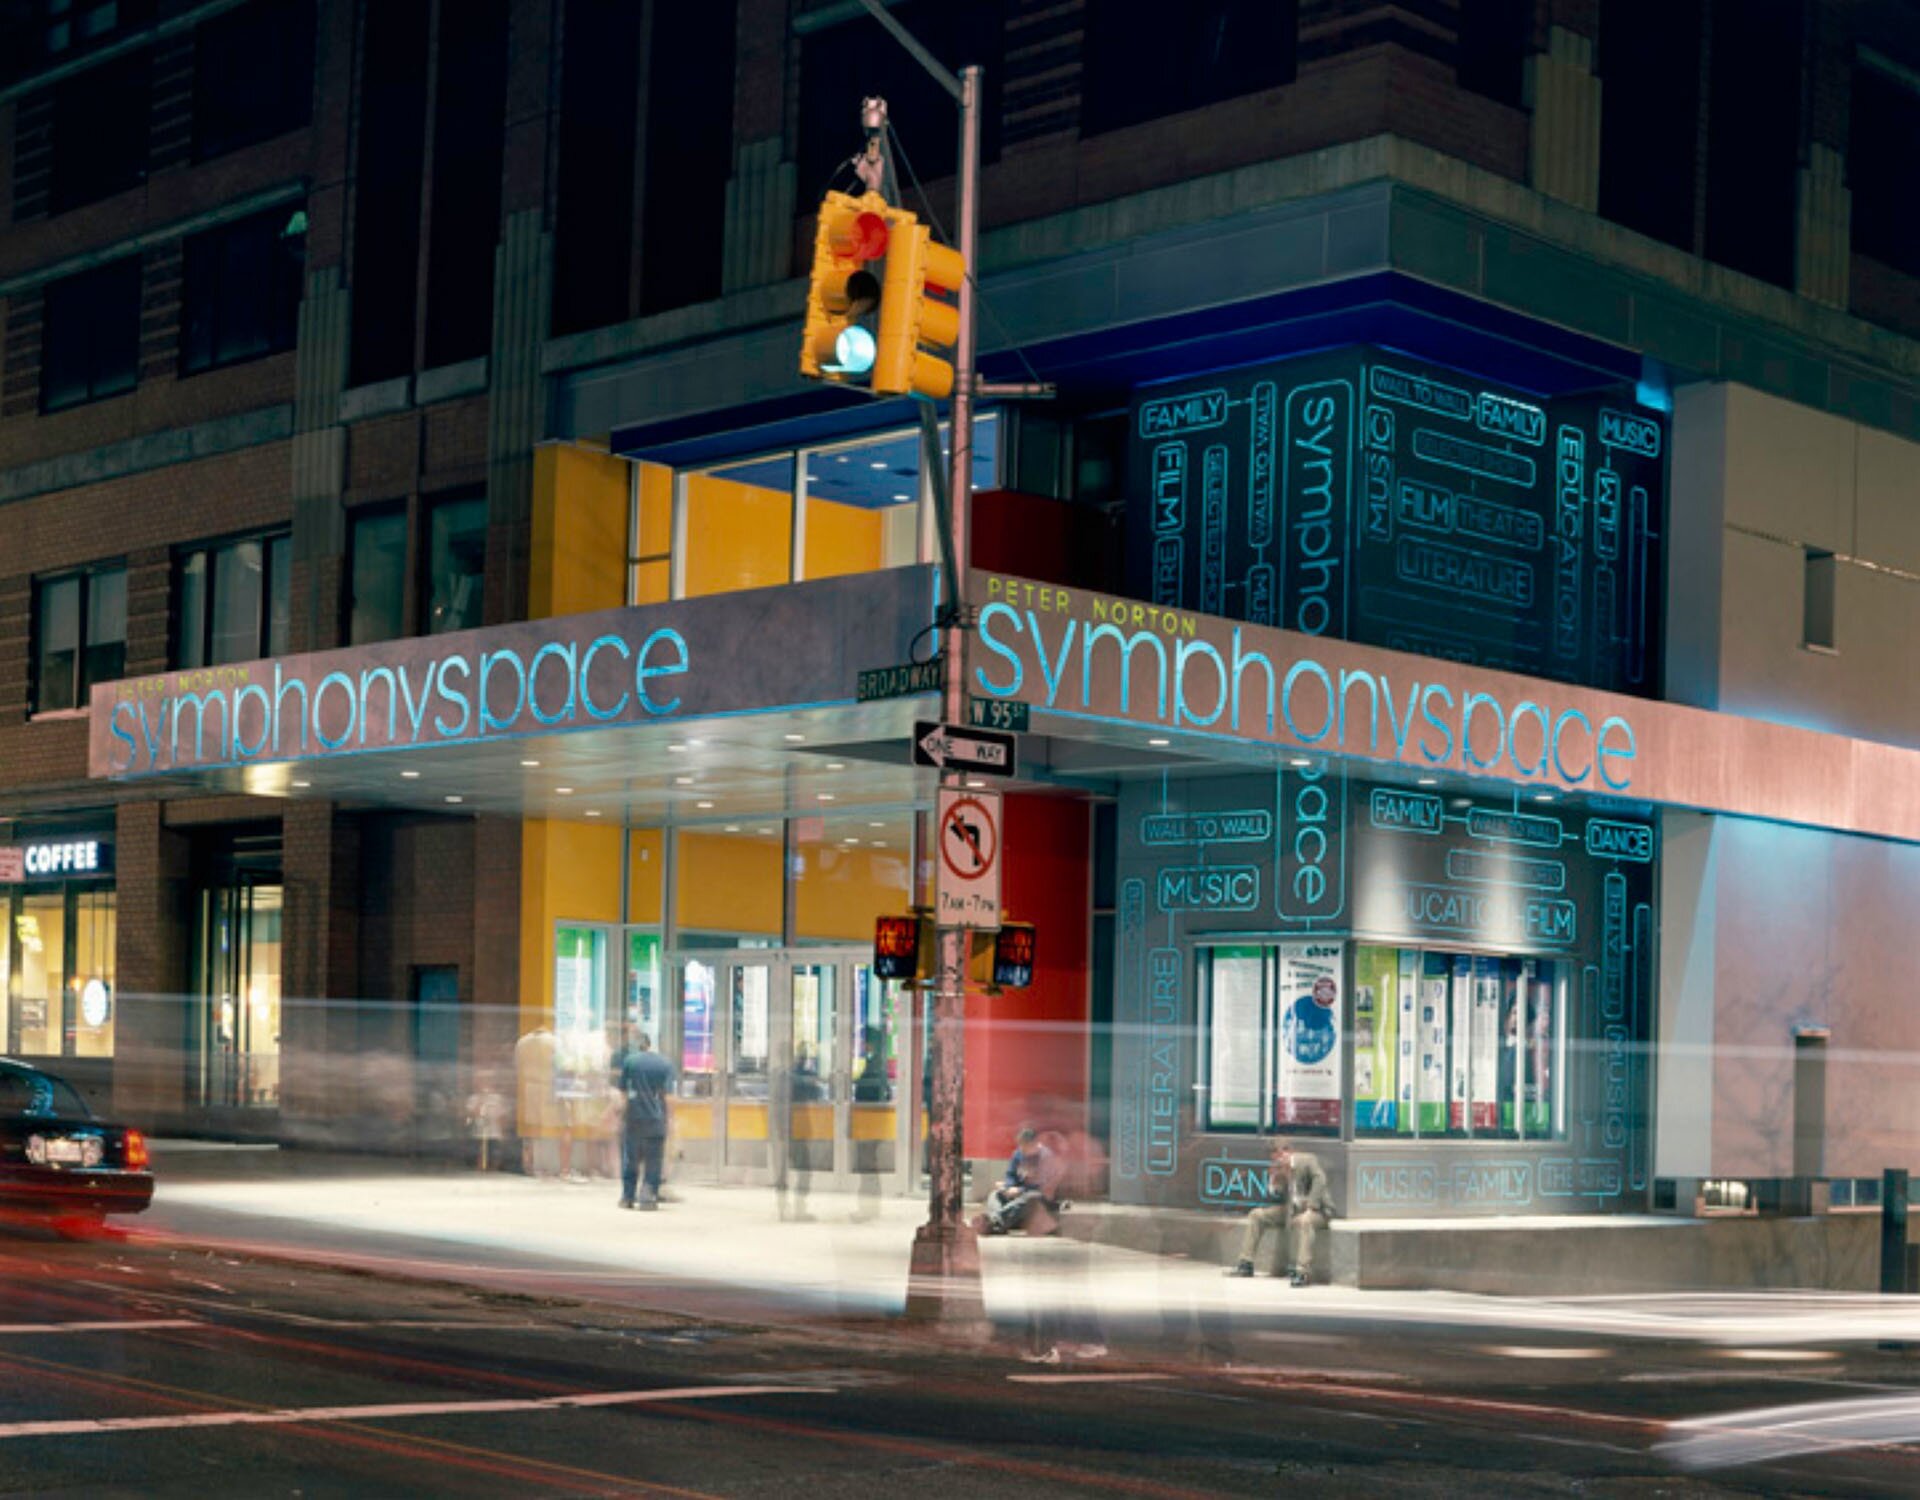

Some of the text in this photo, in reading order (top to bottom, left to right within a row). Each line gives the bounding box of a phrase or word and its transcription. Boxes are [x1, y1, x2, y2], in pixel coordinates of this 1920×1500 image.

[1415, 383, 1433, 404] TO
[1146, 395, 1222, 428] FAMILY
[1482, 400, 1541, 438] FAMILY
[1602, 415, 1657, 449] MUSIC
[1157, 448, 1182, 528] FILM
[1370, 413, 1391, 533] MUSIC
[1402, 485, 1449, 526] FILM
[1459, 501, 1537, 542] THEATRE
[1558, 439, 1579, 649] EDUCATION
[1402, 544, 1529, 601] LITERATURE
[987, 577, 1197, 637] PETER NORTON
[179, 668, 250, 691] NORTON
[858, 665, 938, 699] BROADWAY
[975, 601, 1636, 790] symphonyspace
[110, 627, 689, 769] symphonyspace
[973, 701, 986, 725] W
[926, 736, 1001, 760] ONE WAY
[1195, 820, 1218, 837] TO
[1221, 817, 1265, 835] WALL
[1375, 798, 1440, 828] FAMILY
[25, 841, 98, 873] COFFEE
[1592, 825, 1648, 857] DANCE
[1163, 873, 1253, 905] MUSIC
[1526, 903, 1571, 937] FILM
[1150, 957, 1175, 1166] LITERATURE
[1607, 1030, 1625, 1141] MUSIC
[1205, 1165, 1278, 1199] DAN
[1361, 1168, 1434, 1199] MUSIC
[1454, 1168, 1527, 1199] FAMILY
